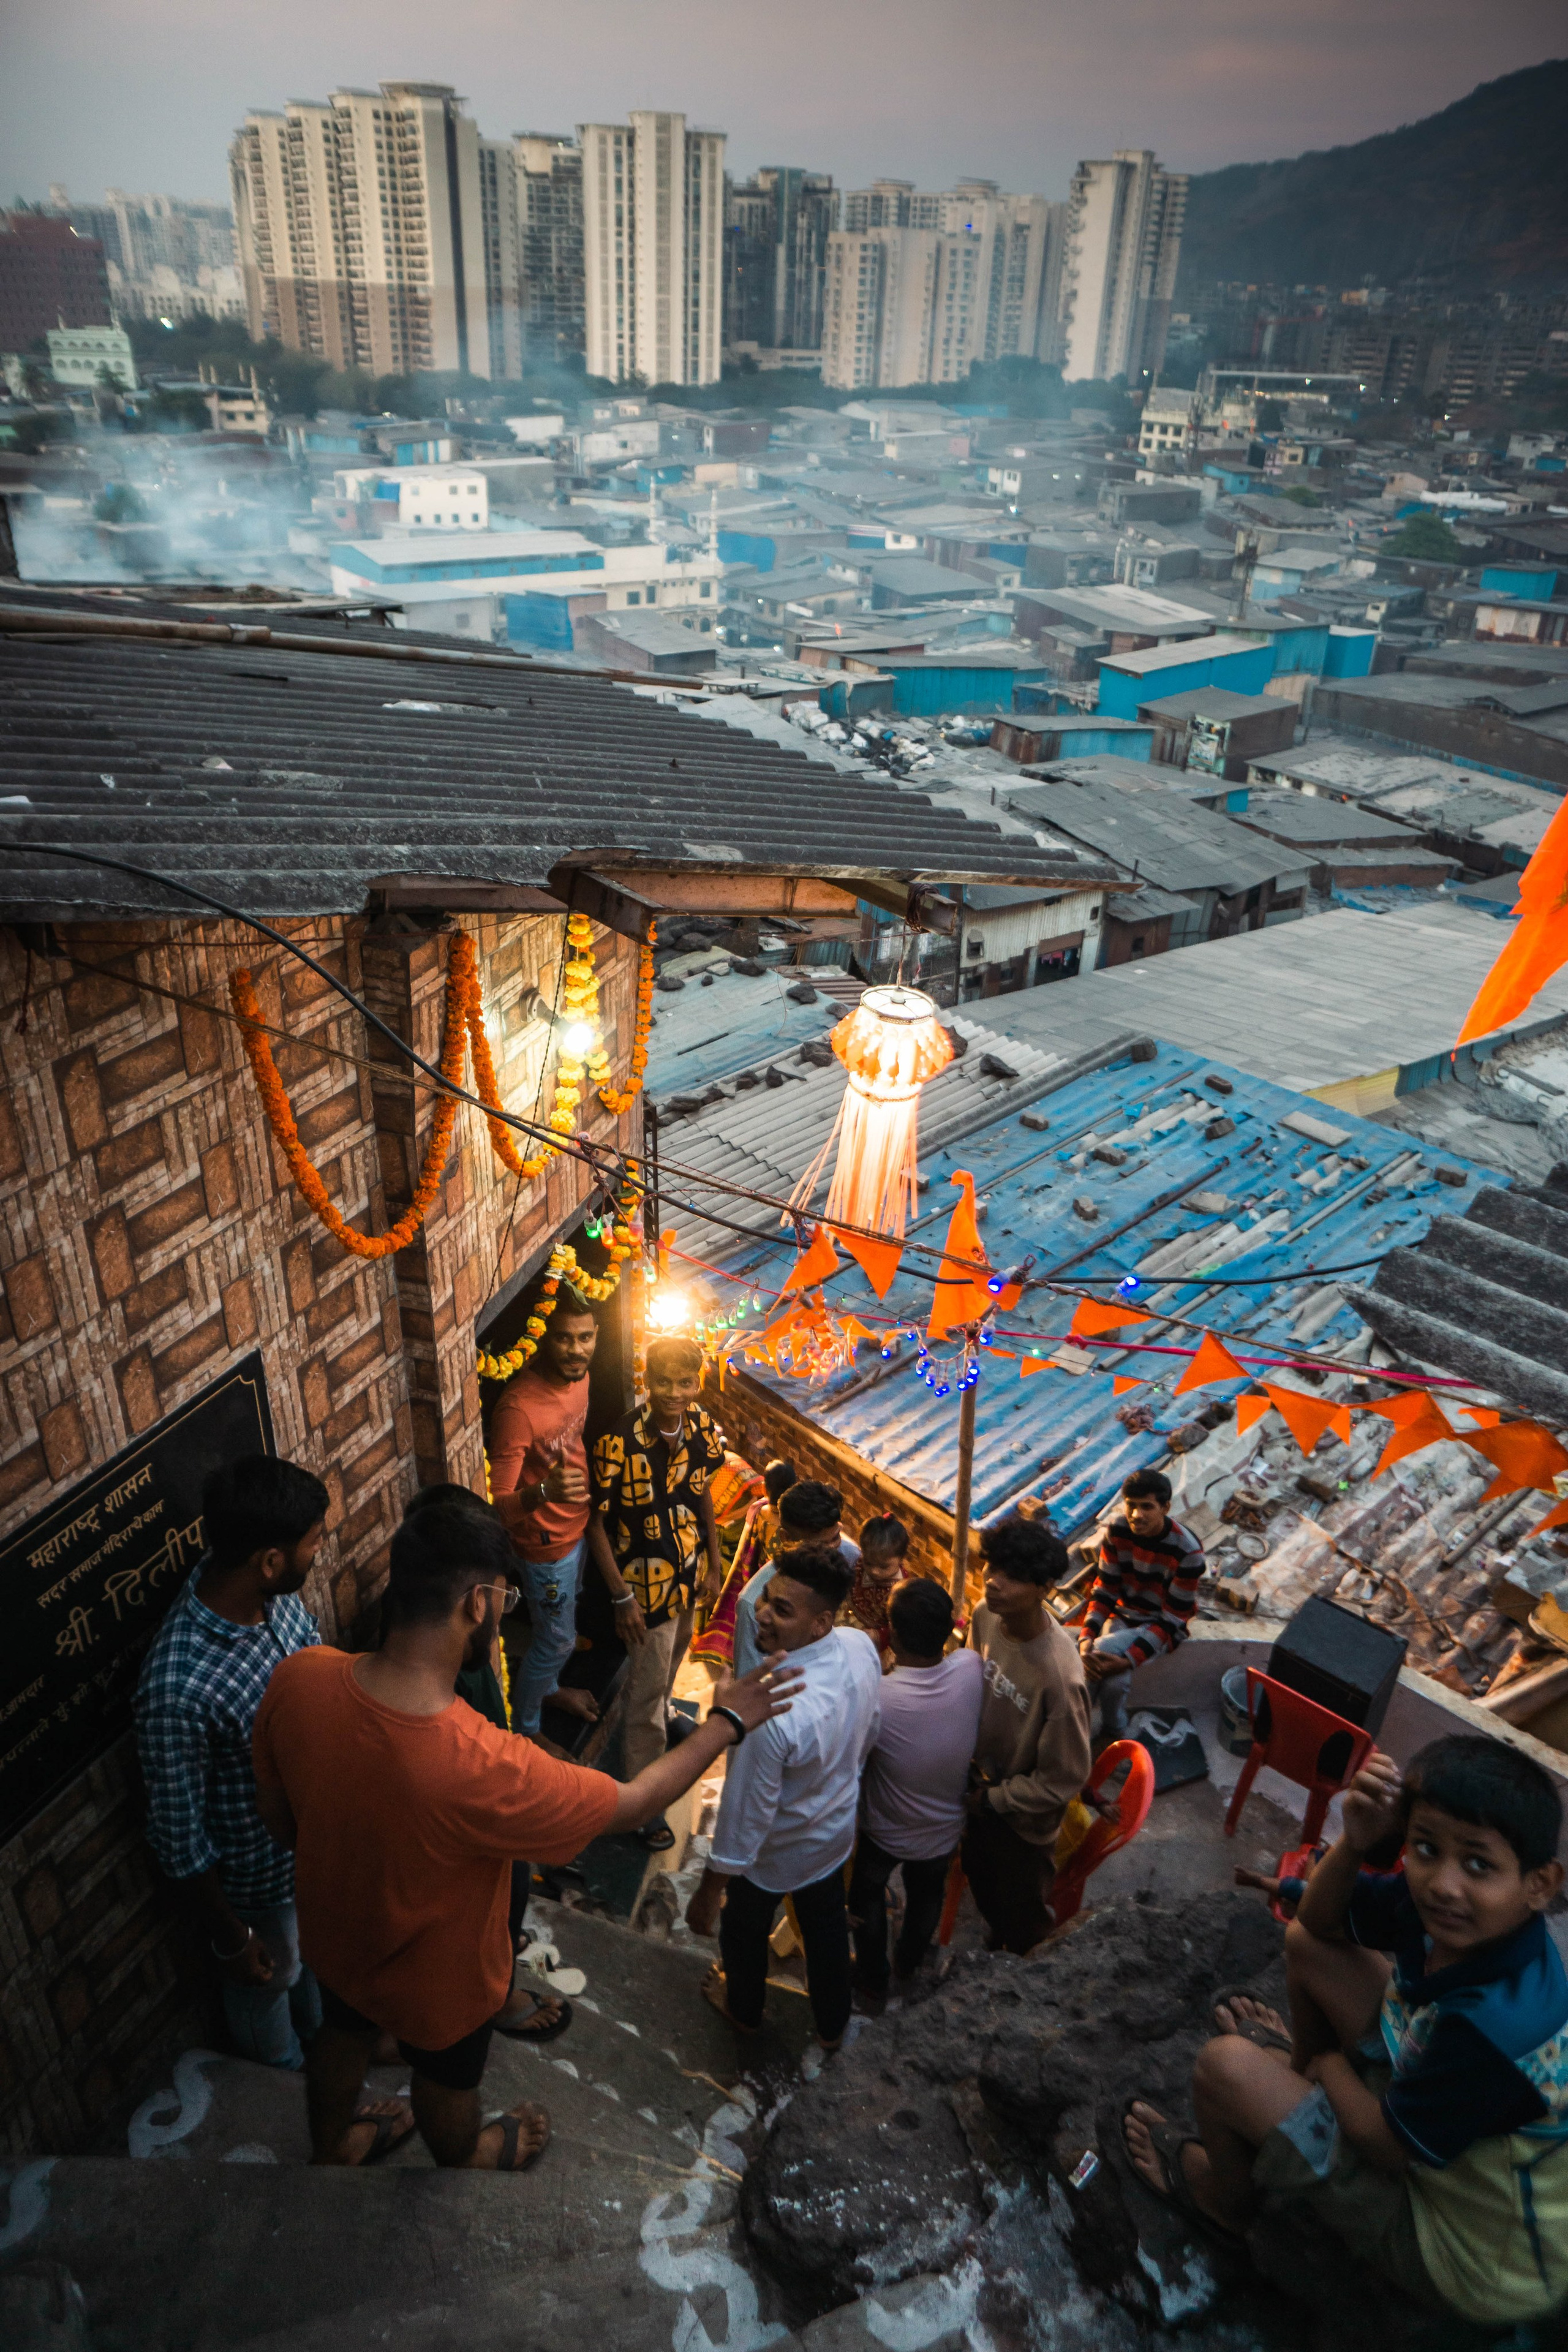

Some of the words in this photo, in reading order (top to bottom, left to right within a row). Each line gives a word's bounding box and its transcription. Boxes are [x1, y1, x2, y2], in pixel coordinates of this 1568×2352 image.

[26, 1503, 101, 1569] महाराष्ट्र
[104, 1463, 153, 1513] शासन
[101, 1515, 205, 1621] दिलीप
[36, 1576, 68, 1609] सदर
